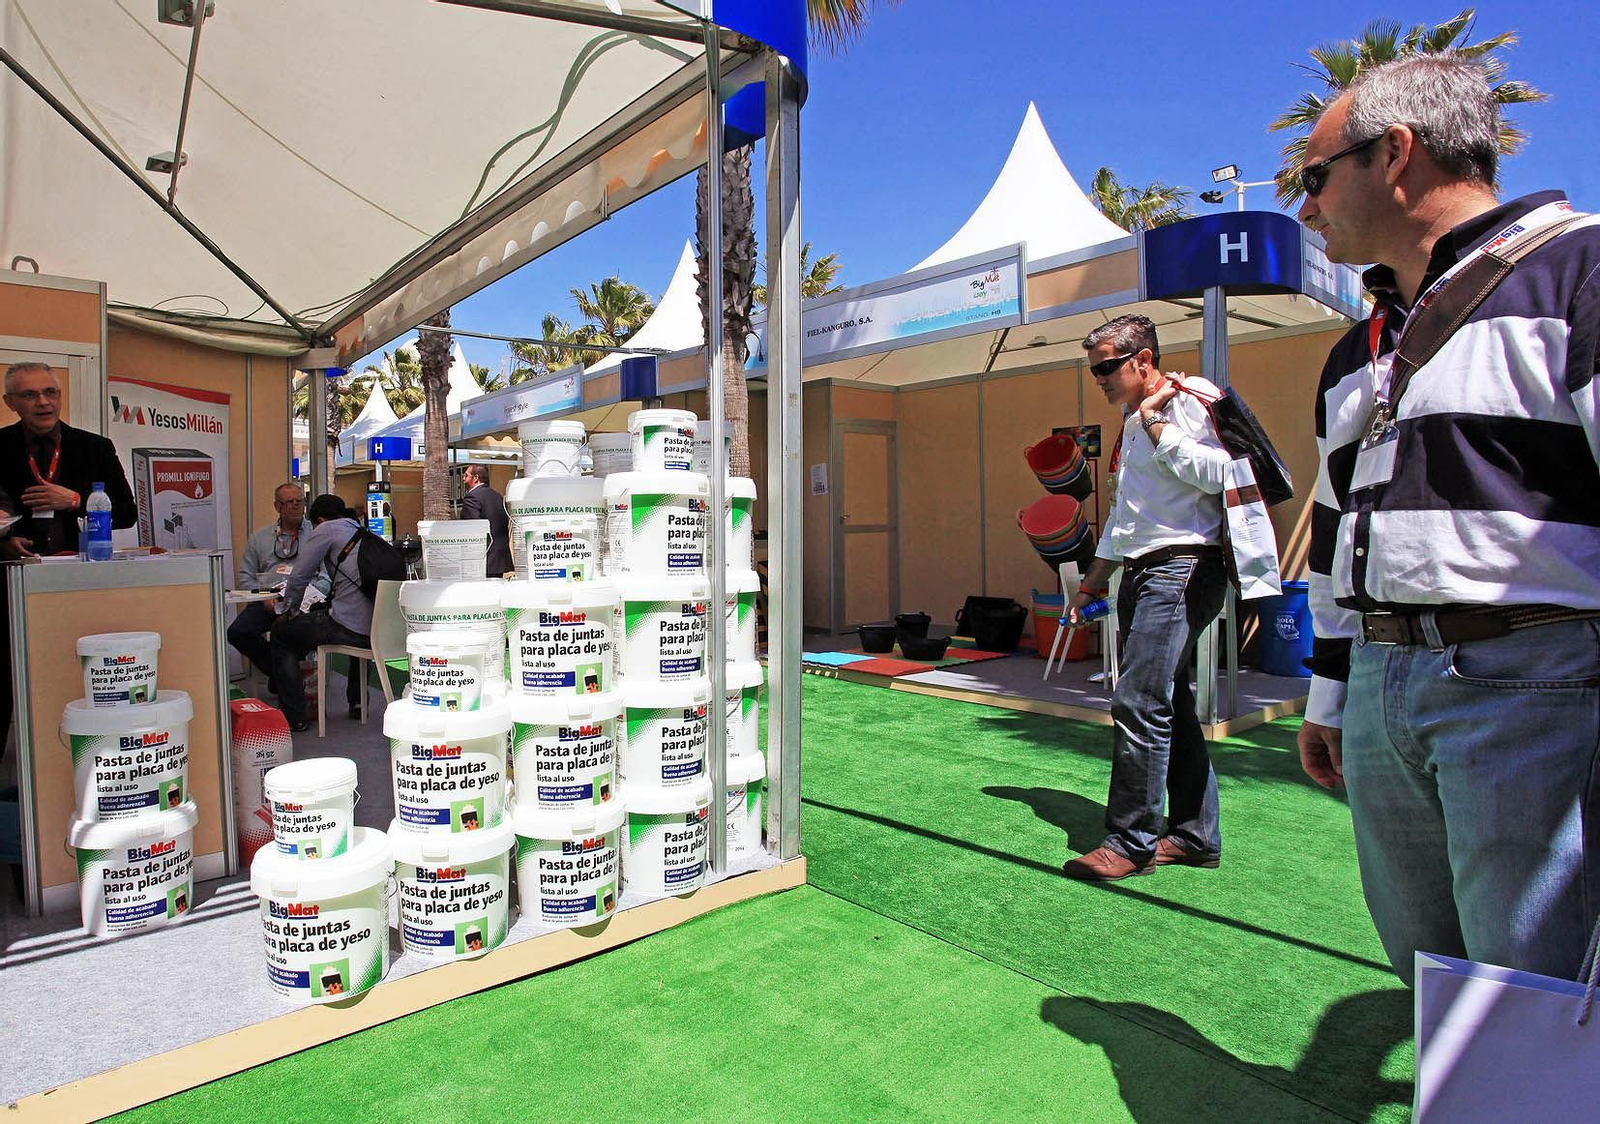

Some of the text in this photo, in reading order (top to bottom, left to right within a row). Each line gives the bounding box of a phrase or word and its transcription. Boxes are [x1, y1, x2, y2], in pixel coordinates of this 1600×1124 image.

[1220, 232, 1248, 263] H
[807, 316, 873, 337] FIEL-KANGURO, S.A.
[148, 408, 223, 434] YesosMillán
[375, 443, 382, 453] H
[157, 472, 183, 482] PROMILL
[668, 514, 694, 525] Pasta
[544, 532, 573, 541] BigMat
[668, 530, 691, 540] para
[564, 542, 585, 551] juntas
[549, 551, 569, 560] placa
[539, 612, 586, 627] BigMat
[660, 621, 689, 632] Pasta
[520, 629, 605, 643] Pasta de juntas
[660, 635, 684, 647] para
[521, 641, 596, 658] para placa de
[104, 656, 136, 666] BigMat
[419, 657, 448, 667] BigMat
[91, 667, 112, 676] Pasta
[126, 664, 149, 675] juntas
[437, 669, 464, 678] juntas
[110, 674, 133, 684] placa
[423, 678, 444, 686] placa
[458, 678, 474, 687] yeso
[558, 725, 602, 742] BigMat
[662, 727, 691, 737] Pasta
[120, 732, 169, 751] BigMat
[662, 741, 686, 753] para
[95, 743, 184, 767] Pasta de juntas
[412, 744, 462, 760] BigMat
[536, 745, 570, 757] Pasta
[573, 744, 588, 756] de
[396, 760, 486, 779] Pasta de juntas
[537, 753, 609, 773] para placa de
[96, 758, 178, 784] para placa de
[397, 772, 499, 794] para placa de yeso
[274, 802, 303, 813] BigMat
[283, 814, 322, 825] de juntas
[280, 821, 336, 833] placa de yeso
[664, 832, 693, 843] Pasta
[128, 840, 176, 863] BigMat
[562, 837, 605, 856] BigMat
[664, 846, 689, 857] para
[102, 849, 191, 879] Pasta de juntas
[539, 858, 573, 870] Pasta
[576, 857, 591, 868] de
[104, 864, 185, 895] para placa de
[416, 867, 467, 883] BigMat
[540, 862, 612, 885] para placa de
[401, 880, 490, 901] Pasta de juntas
[541, 887, 555, 895] lista
[105, 896, 121, 904] lista
[401, 889, 503, 916] para placa de yeso
[269, 900, 320, 920] BigMat
[283, 920, 350, 940] de juntas
[279, 928, 371, 953] placa de yeso
[276, 956, 287, 965] uso
